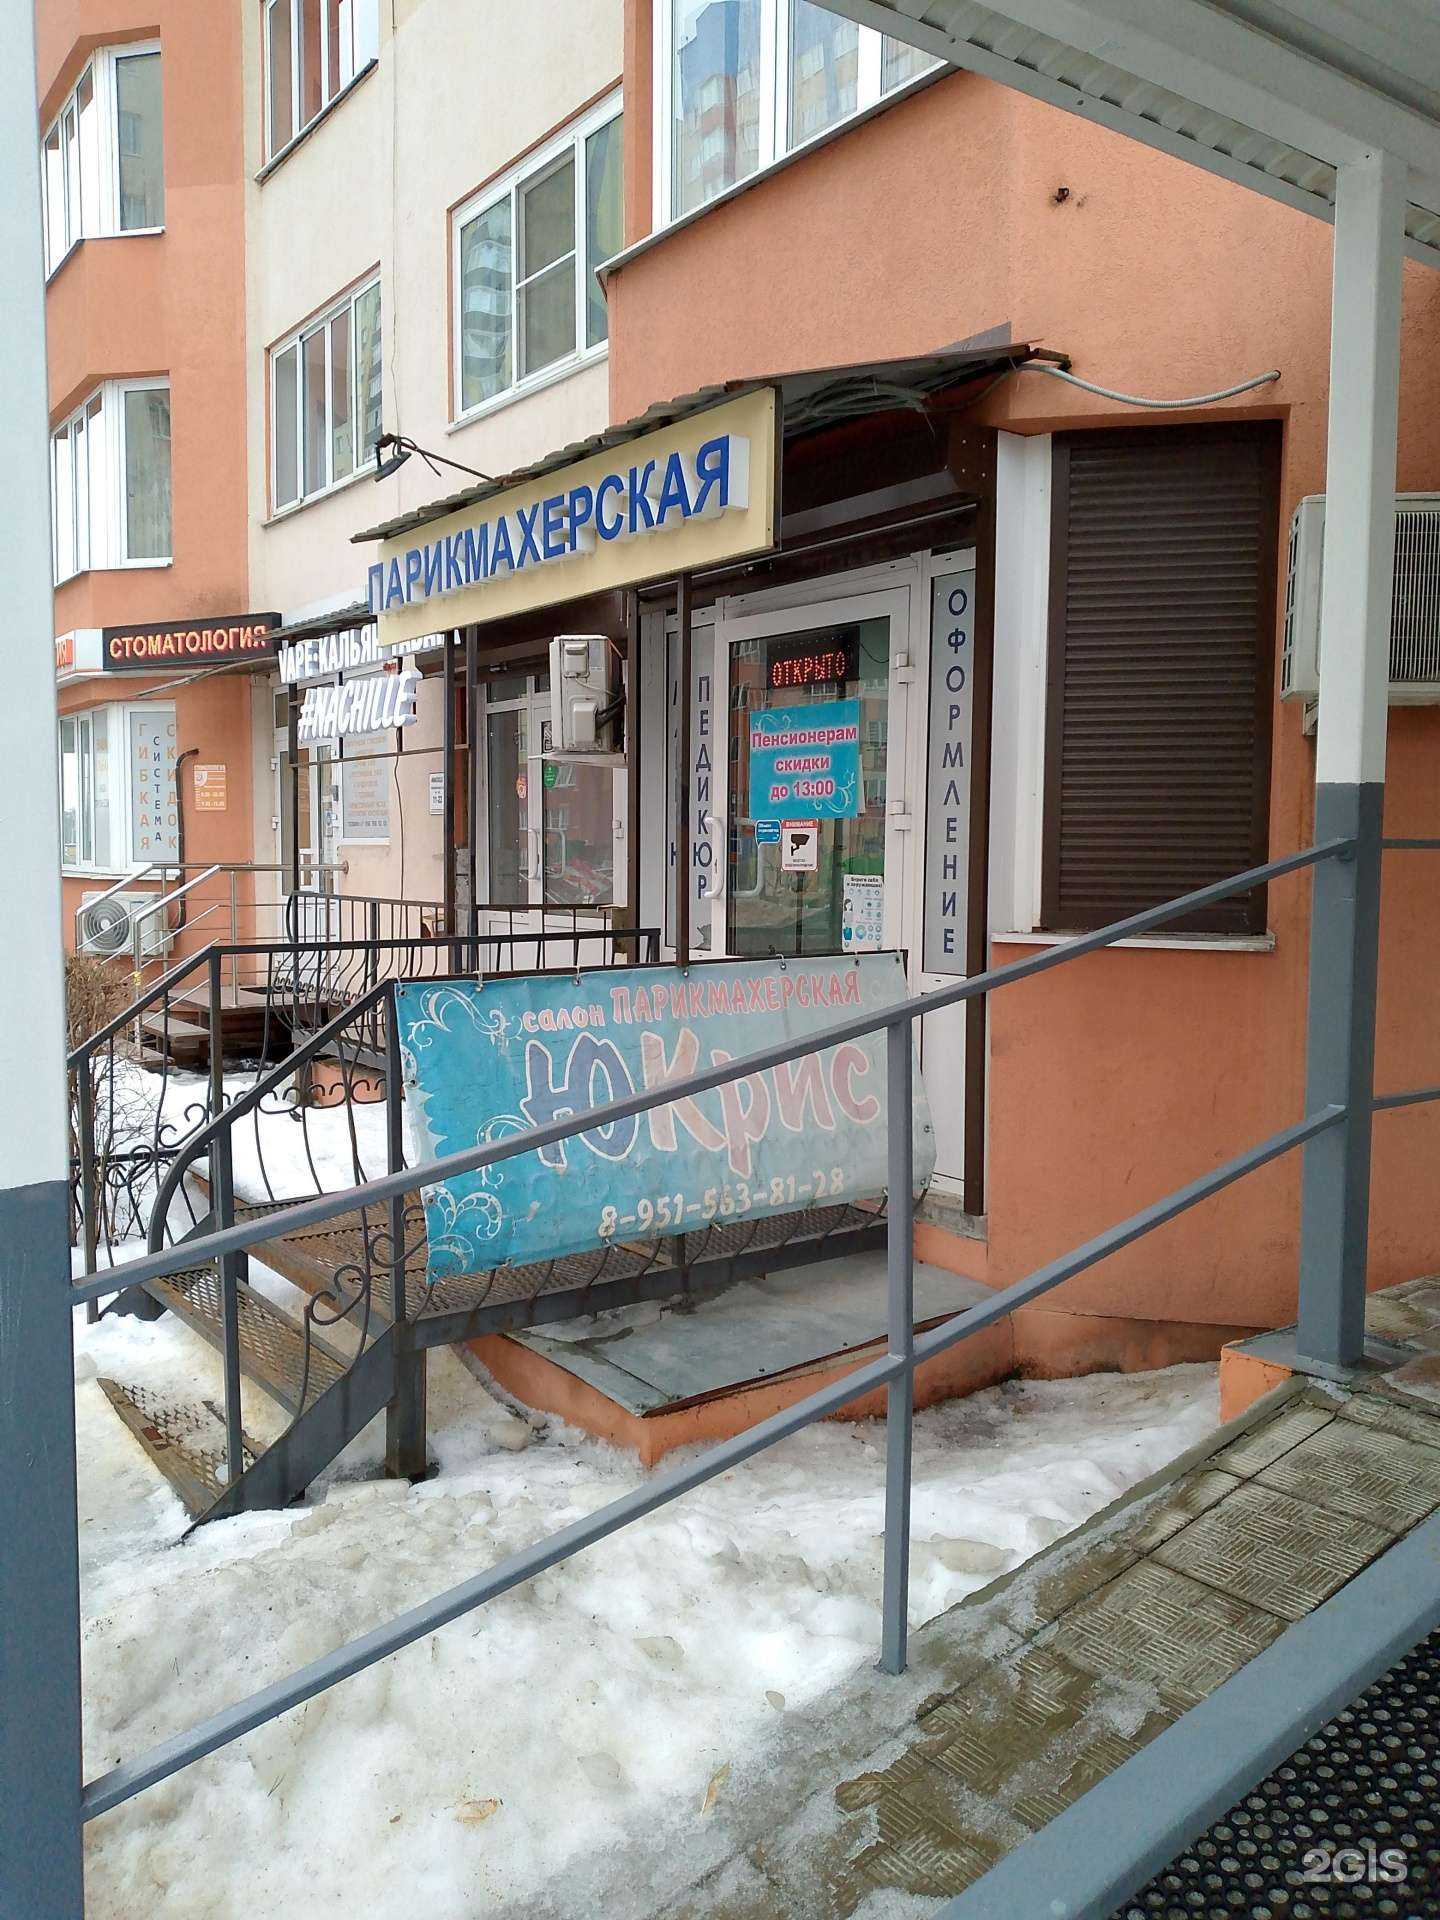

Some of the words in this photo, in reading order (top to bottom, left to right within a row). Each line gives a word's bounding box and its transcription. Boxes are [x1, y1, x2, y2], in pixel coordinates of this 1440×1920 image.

[367, 435, 730, 614] ПАРИКМАХЕРСКАЯ
[109, 625, 266, 659] СТОМАТОЛОГИЯ
[772, 651, 846, 687] ОТКРЫТО
[751, 726, 857, 748] Пенсионерам
[775, 756, 830, 773] скидки
[138, 723, 151, 850] ГИБКАЯ
[153, 735, 162, 842] СИСТЕМА
[693, 675, 713, 899] ПЕДИКЮР
[770, 785, 788, 801] до
[794, 779, 834, 797] 13:00
[942, 588, 966, 954] ОФОРМЛЕНИЕ
[522, 1004, 606, 1033] салон
[610, 970, 862, 1025] ПАРИКМАХЕРСКАЯ
[599, 1168, 845, 1238] 8-951-563-81-28
